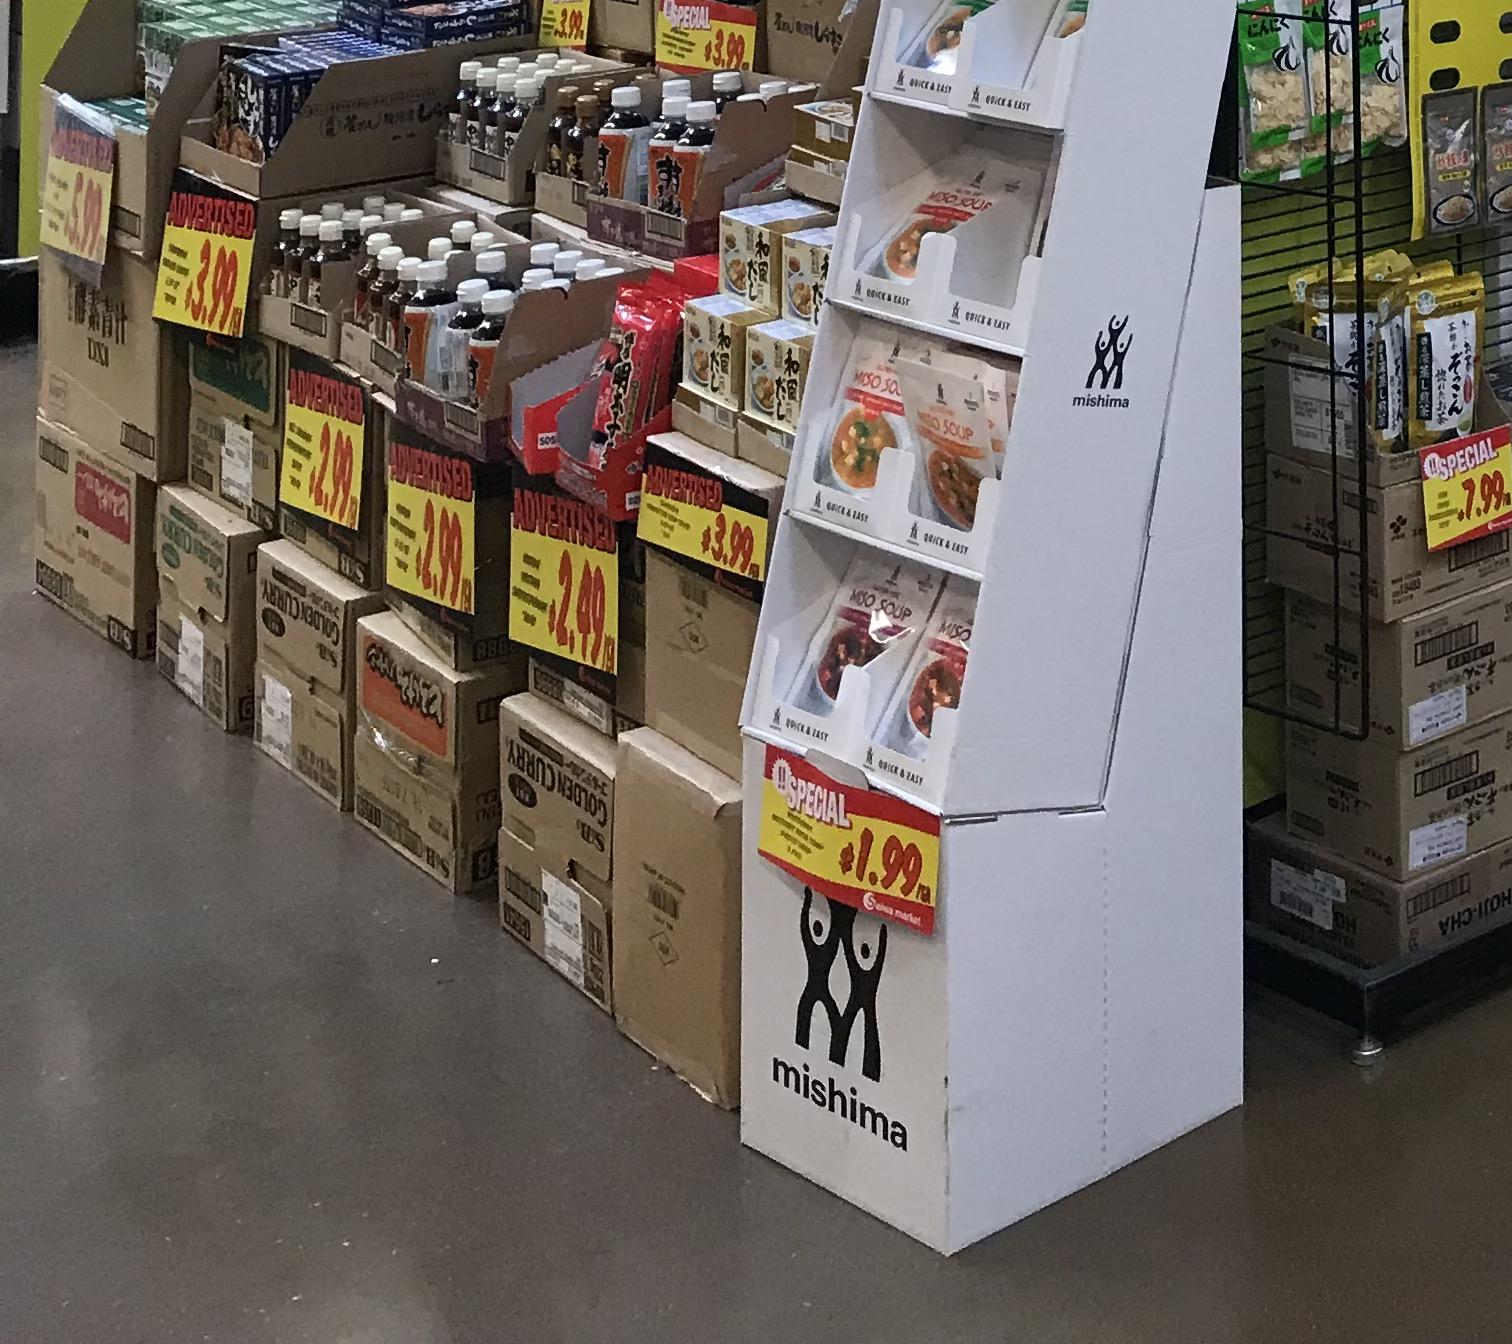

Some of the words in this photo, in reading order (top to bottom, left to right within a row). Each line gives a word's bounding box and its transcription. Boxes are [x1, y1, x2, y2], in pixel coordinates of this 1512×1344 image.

[673, 2, 711, 31] SPECIAL
[909, 76, 927, 92] QUICK
[936, 81, 953, 95] EASY
[985, 92, 1005, 108] QUICK
[1014, 97, 1031, 112] EASY
[166, 191, 255, 239] ADVERTISED
[288, 368, 364, 425] ADVERTISED
[1072, 393, 1130, 409] mishima
[942, 421, 974, 441] SOUP
[389, 441, 472, 501] ADVERTISED
[1440, 438, 1498, 482] SPECIAL
[646, 464, 724, 513] ADVERTISED
[825, 500, 843, 515] QUICK
[852, 506, 869, 523] EASY
[512, 488, 616, 554] ADVERTISED
[923, 530, 942, 546] QUICK
[951, 538, 970, 555] EASY
[785, 717, 804, 733] QUICK
[813, 724, 829, 742] EASY
[506, 736, 557, 796] CURRY
[878, 758, 898, 774] QUICK
[908, 768, 925, 787] EASY
[557, 772, 608, 828] GOLDEN
[787, 775, 853, 830] SPECIAL
[839, 827, 923, 897] $1.99
[772, 1053, 909, 1152] mishima
